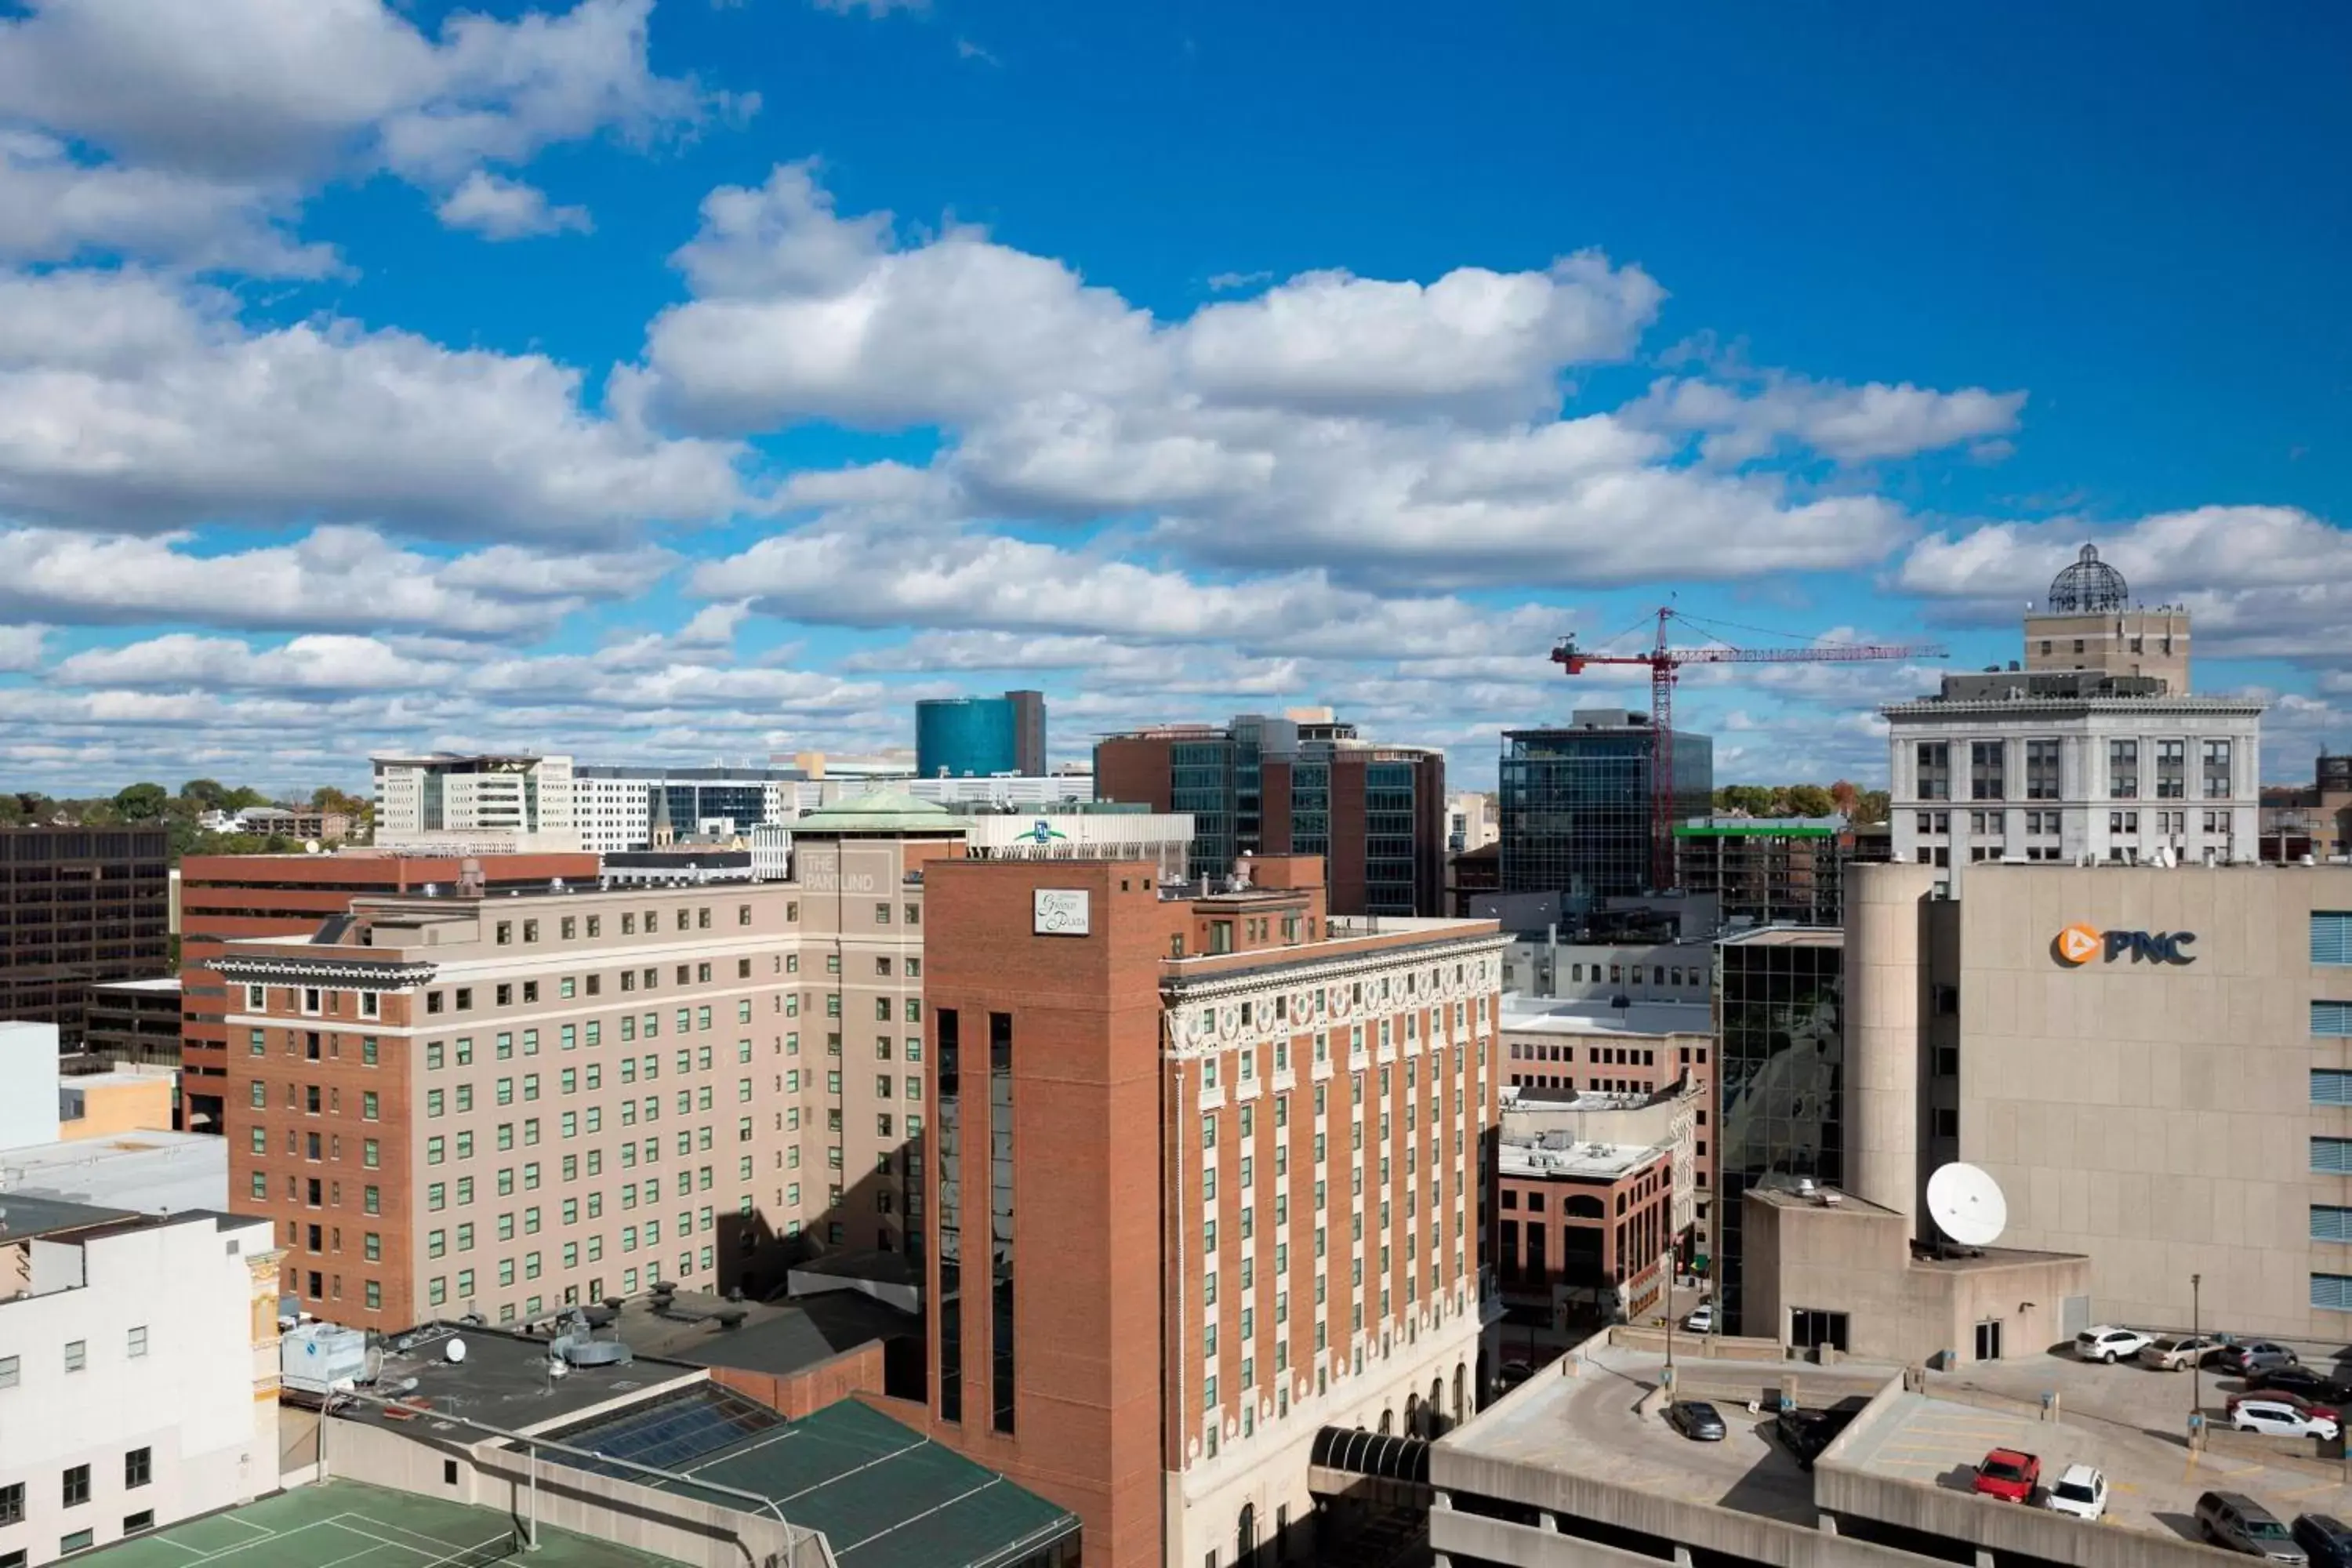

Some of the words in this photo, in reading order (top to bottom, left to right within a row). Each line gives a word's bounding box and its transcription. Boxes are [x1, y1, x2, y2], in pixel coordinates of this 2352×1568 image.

[803, 855, 834, 871] THE
[805, 873, 874, 891] PANTLIND
[2100, 930, 2198, 965] PNC
